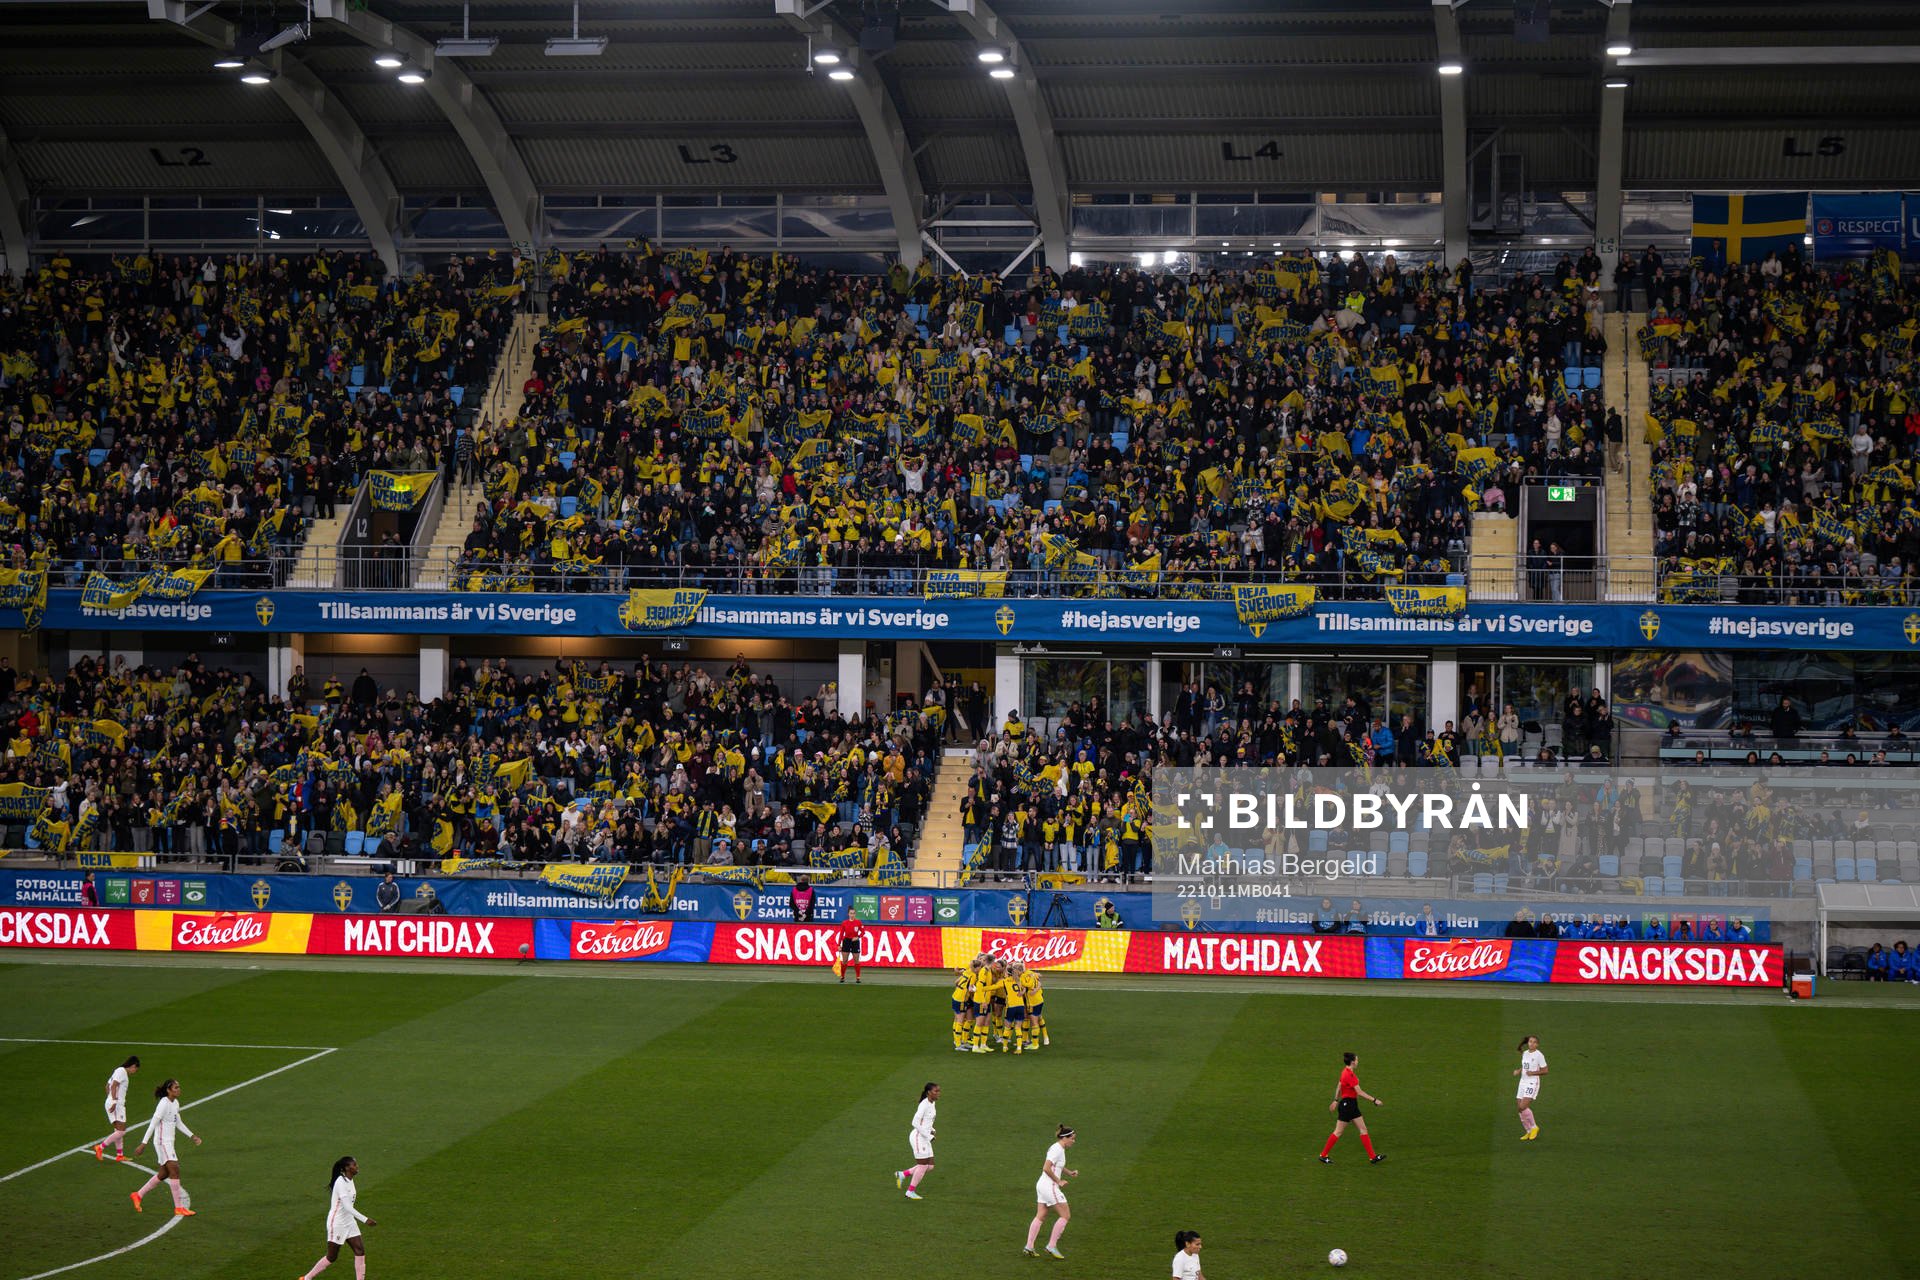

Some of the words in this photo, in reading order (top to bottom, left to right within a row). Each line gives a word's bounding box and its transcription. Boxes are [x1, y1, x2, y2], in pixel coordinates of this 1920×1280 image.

[149, 147, 212, 167] L2
[678, 144, 738, 164] L3
[1222, 140, 1283, 161] L4
[1783, 136, 1846, 157] L5
[1838, 220, 1900, 233] RESPECT
[356, 518, 368, 538] L2
[1238, 586, 1268, 599] HEJA
[1239, 593, 1297, 613] SVERIGE!
[1388, 589, 1419, 600] HEJA
[318, 602, 448, 621] Tillsammans
[451, 603, 472, 621] är
[476, 603, 495, 621] vi
[498, 604, 576, 625] Sverige
[695, 607, 816, 625] illsammans
[820, 607, 842, 625] är
[845, 608, 864, 626] vi
[868, 608, 949, 630] Sverige
[1062, 610, 1200, 633] #hejasverige
[1315, 613, 1454, 631] Tillsammans
[1486, 614, 1505, 632] vi
[1509, 614, 1593, 637] Sverige
[1709, 616, 1854, 640] #hejasverige
[671, 642, 681, 650] K2
[16, 889, 82, 902] SAMHÄLLE
[758, 908, 837, 919] SAMHLET
[177, 917, 263, 946] Estrella
[344, 919, 495, 954] MATCHDAX
[576, 926, 665, 955] Estrella
[990, 935, 1077, 964] Estrella
[1164, 937, 1323, 973] MATCHDAX
[1409, 938, 1505, 974] Estrella
[1578, 946, 1769, 982] SNACKSDAX
[1011, 983, 1021, 993] 9
